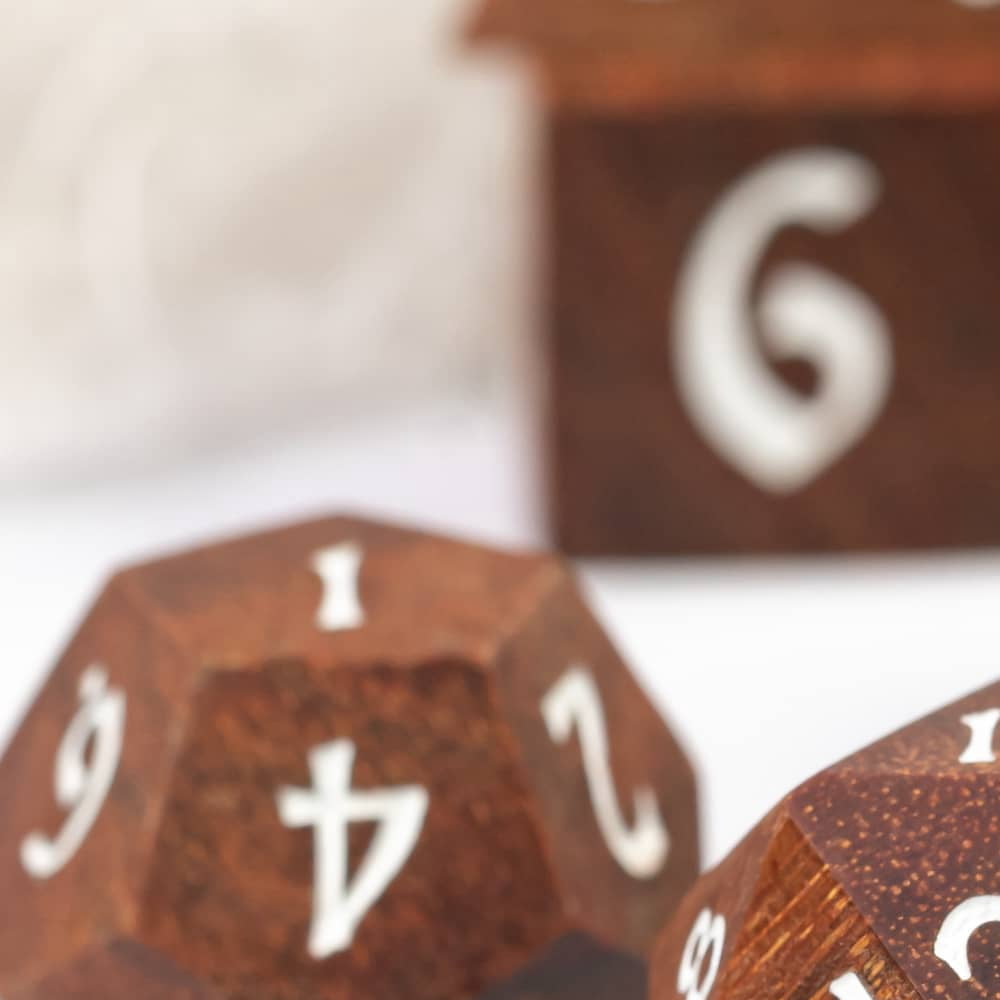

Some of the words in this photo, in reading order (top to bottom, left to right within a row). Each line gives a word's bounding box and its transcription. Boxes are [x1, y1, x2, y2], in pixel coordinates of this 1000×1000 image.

[676, 148, 890, 491] 6
[314, 545, 363, 631] 1
[276, 739, 429, 959] 4
